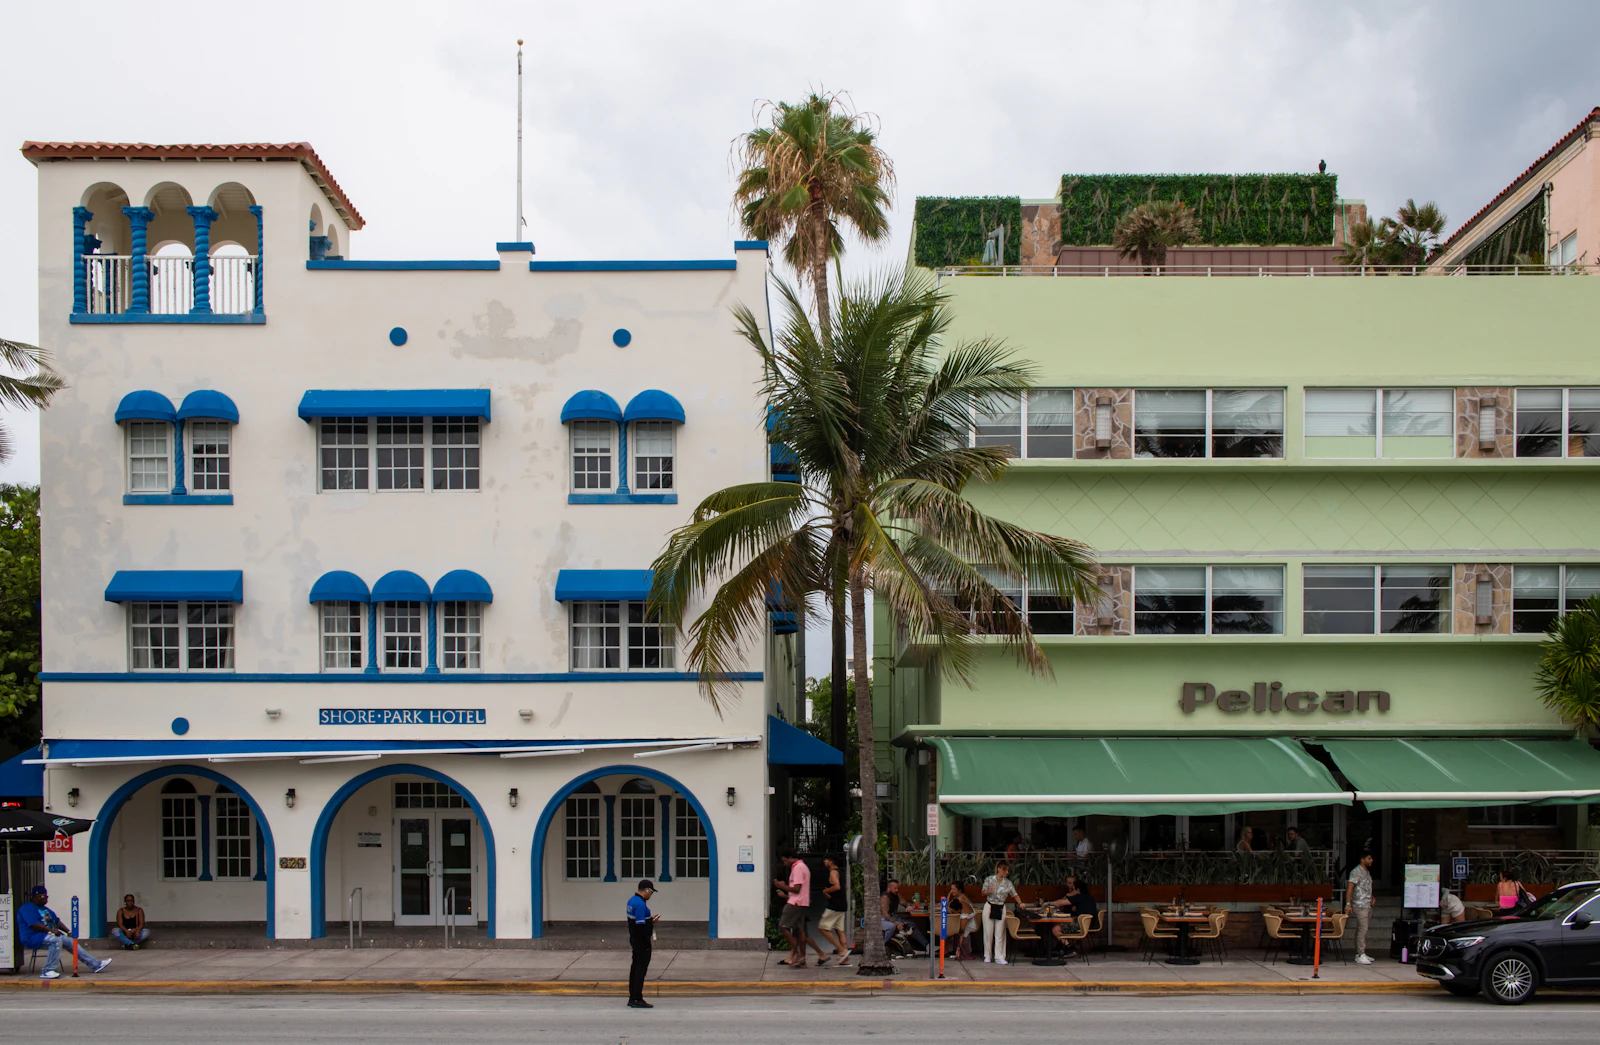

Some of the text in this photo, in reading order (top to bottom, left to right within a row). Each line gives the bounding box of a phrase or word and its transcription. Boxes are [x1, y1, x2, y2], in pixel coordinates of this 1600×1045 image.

[1178, 681, 1391, 713] Pelican
[429, 709, 485, 724] HOTEL
[49, 838, 70, 849] FDC
